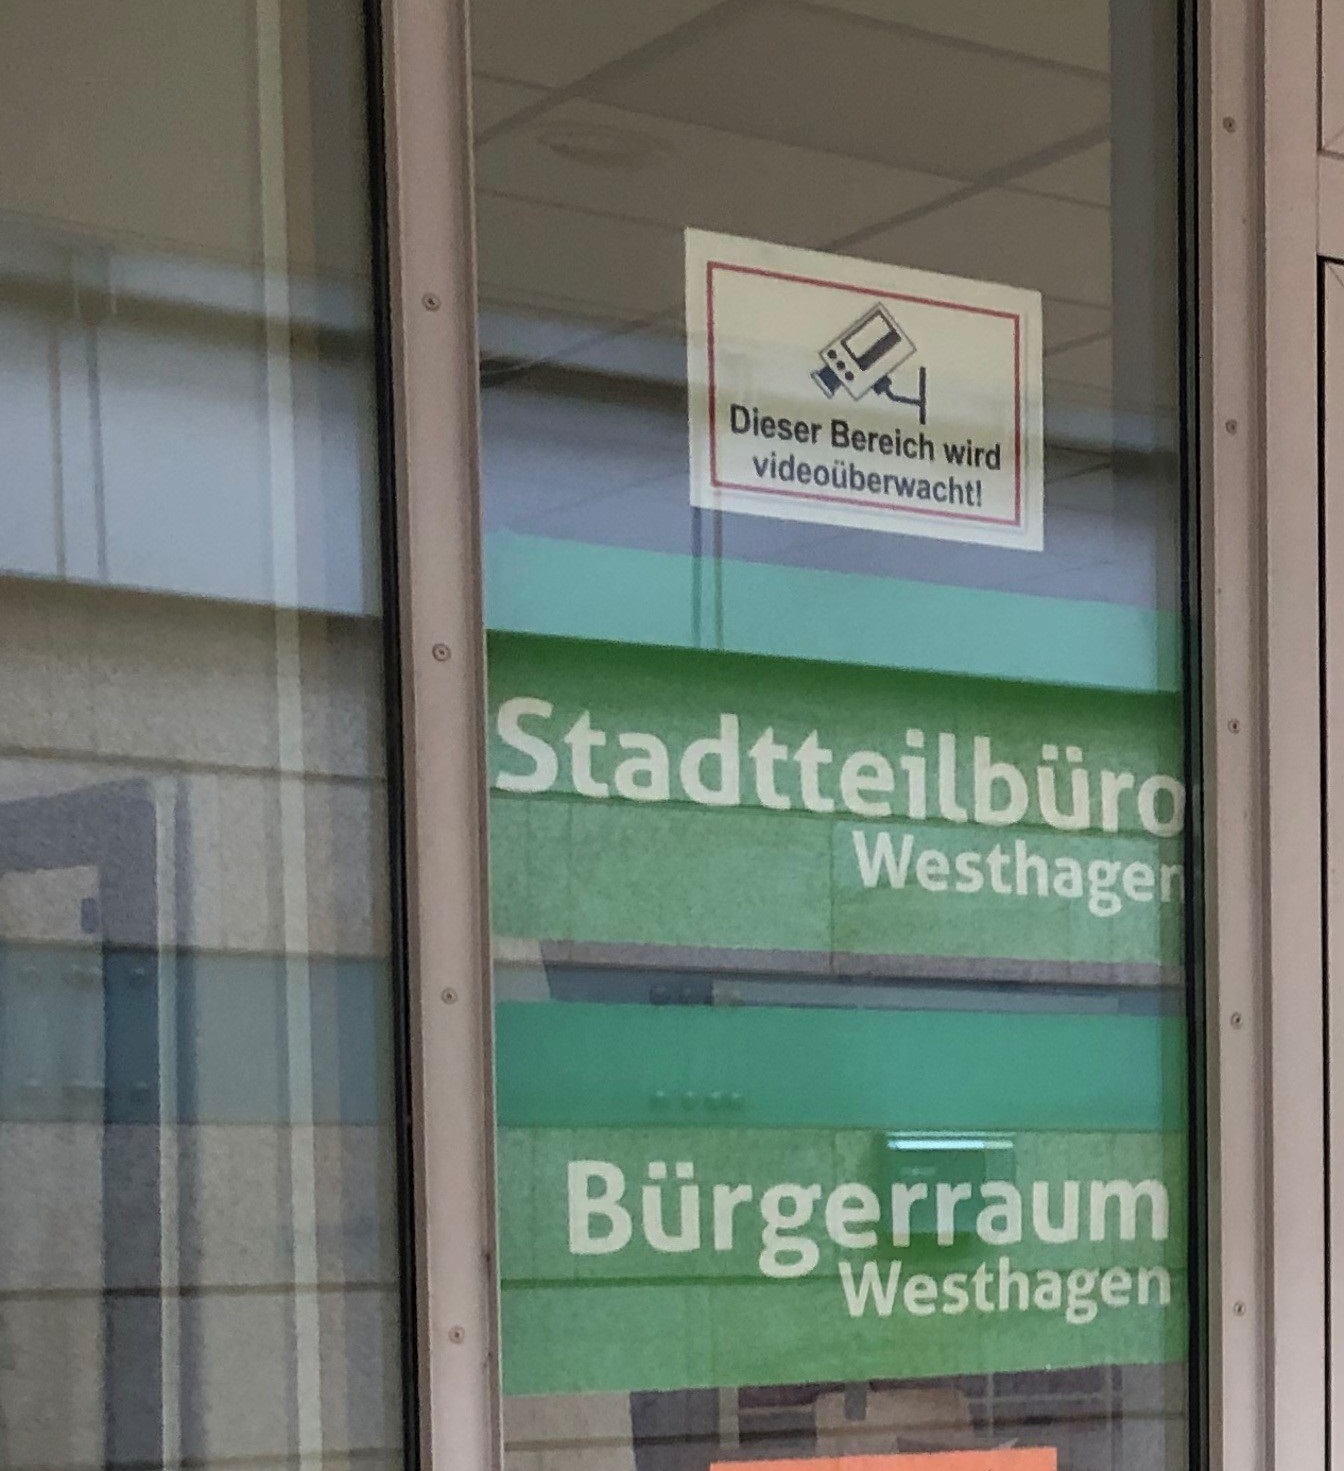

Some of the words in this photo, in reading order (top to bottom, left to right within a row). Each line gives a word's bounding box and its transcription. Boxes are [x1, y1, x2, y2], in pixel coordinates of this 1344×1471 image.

[729, 403, 823, 445] Dieser
[830, 419, 935, 462] Bereich
[943, 439, 1001, 471] wird
[752, 450, 983, 508] videoüberwacht!
[496, 696, 1187, 838] Stadtteilbüro
[851, 830, 1185, 918] Westhagen
[567, 1160, 1171, 1279] Bürgerraum
[837, 1256, 1172, 1325] Westhagen
